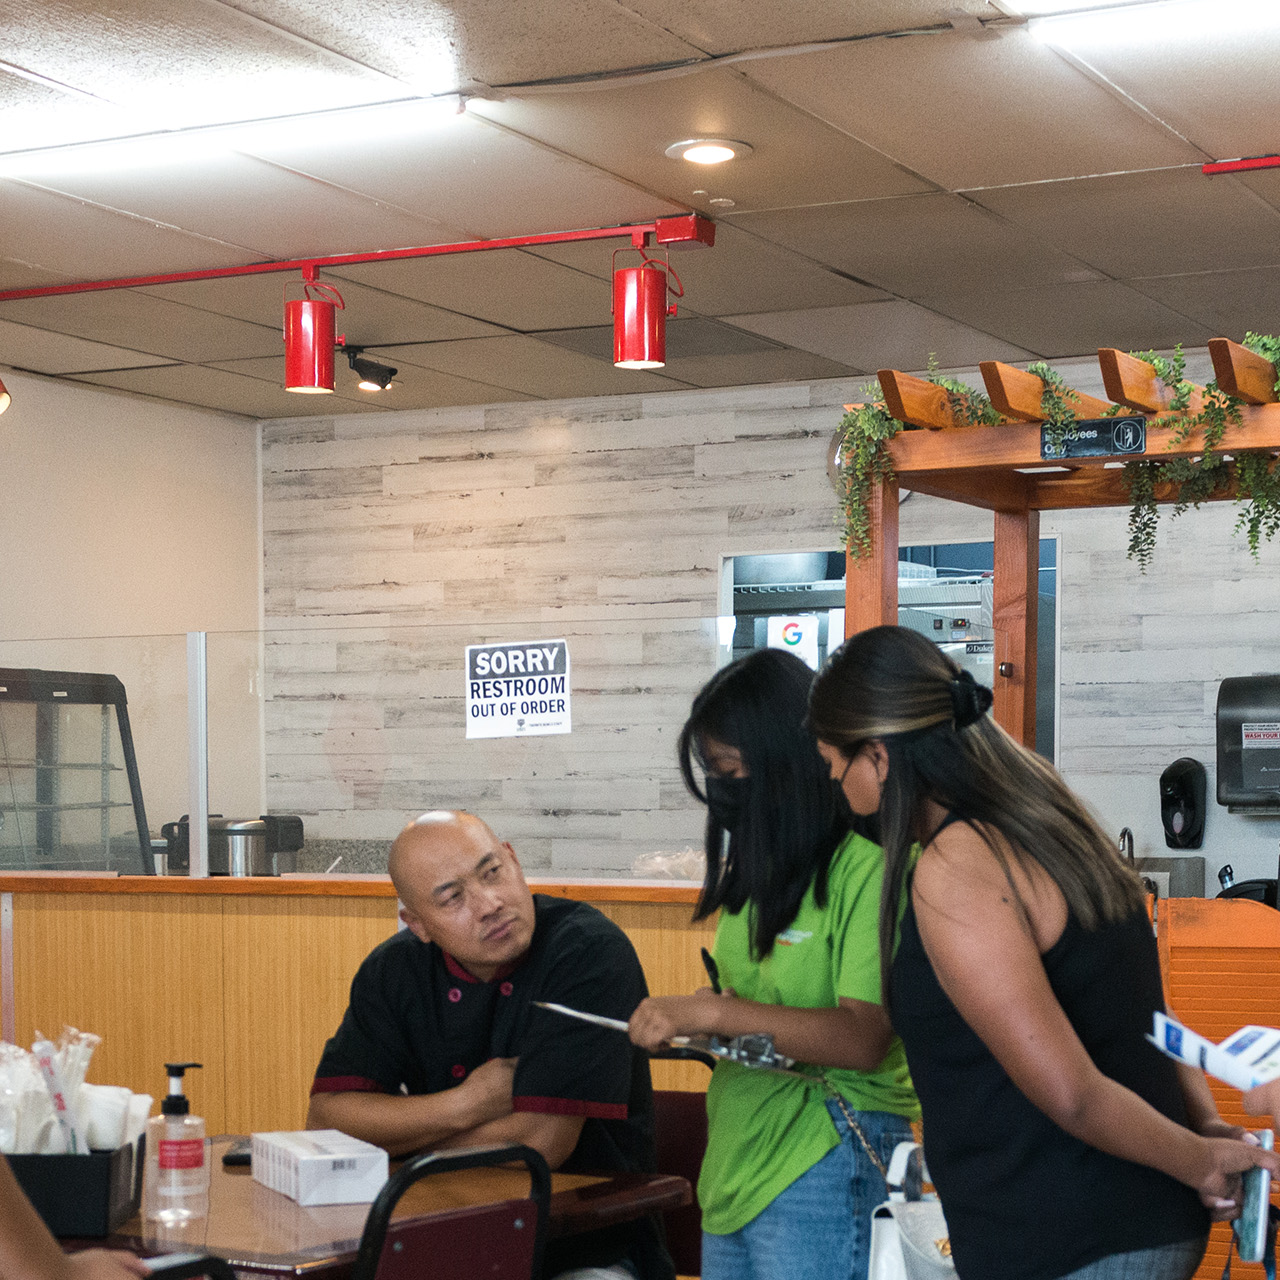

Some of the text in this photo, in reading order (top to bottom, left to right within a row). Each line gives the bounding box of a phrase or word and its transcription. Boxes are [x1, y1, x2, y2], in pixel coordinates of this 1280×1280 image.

[1044, 430, 1098, 442] Eloyees
[1044, 444, 1067, 454] Ony
[475, 648, 558, 675] SORRY
[470, 676, 566, 700] RESTROOM
[471, 698, 566, 718] OUT OF ORDER
